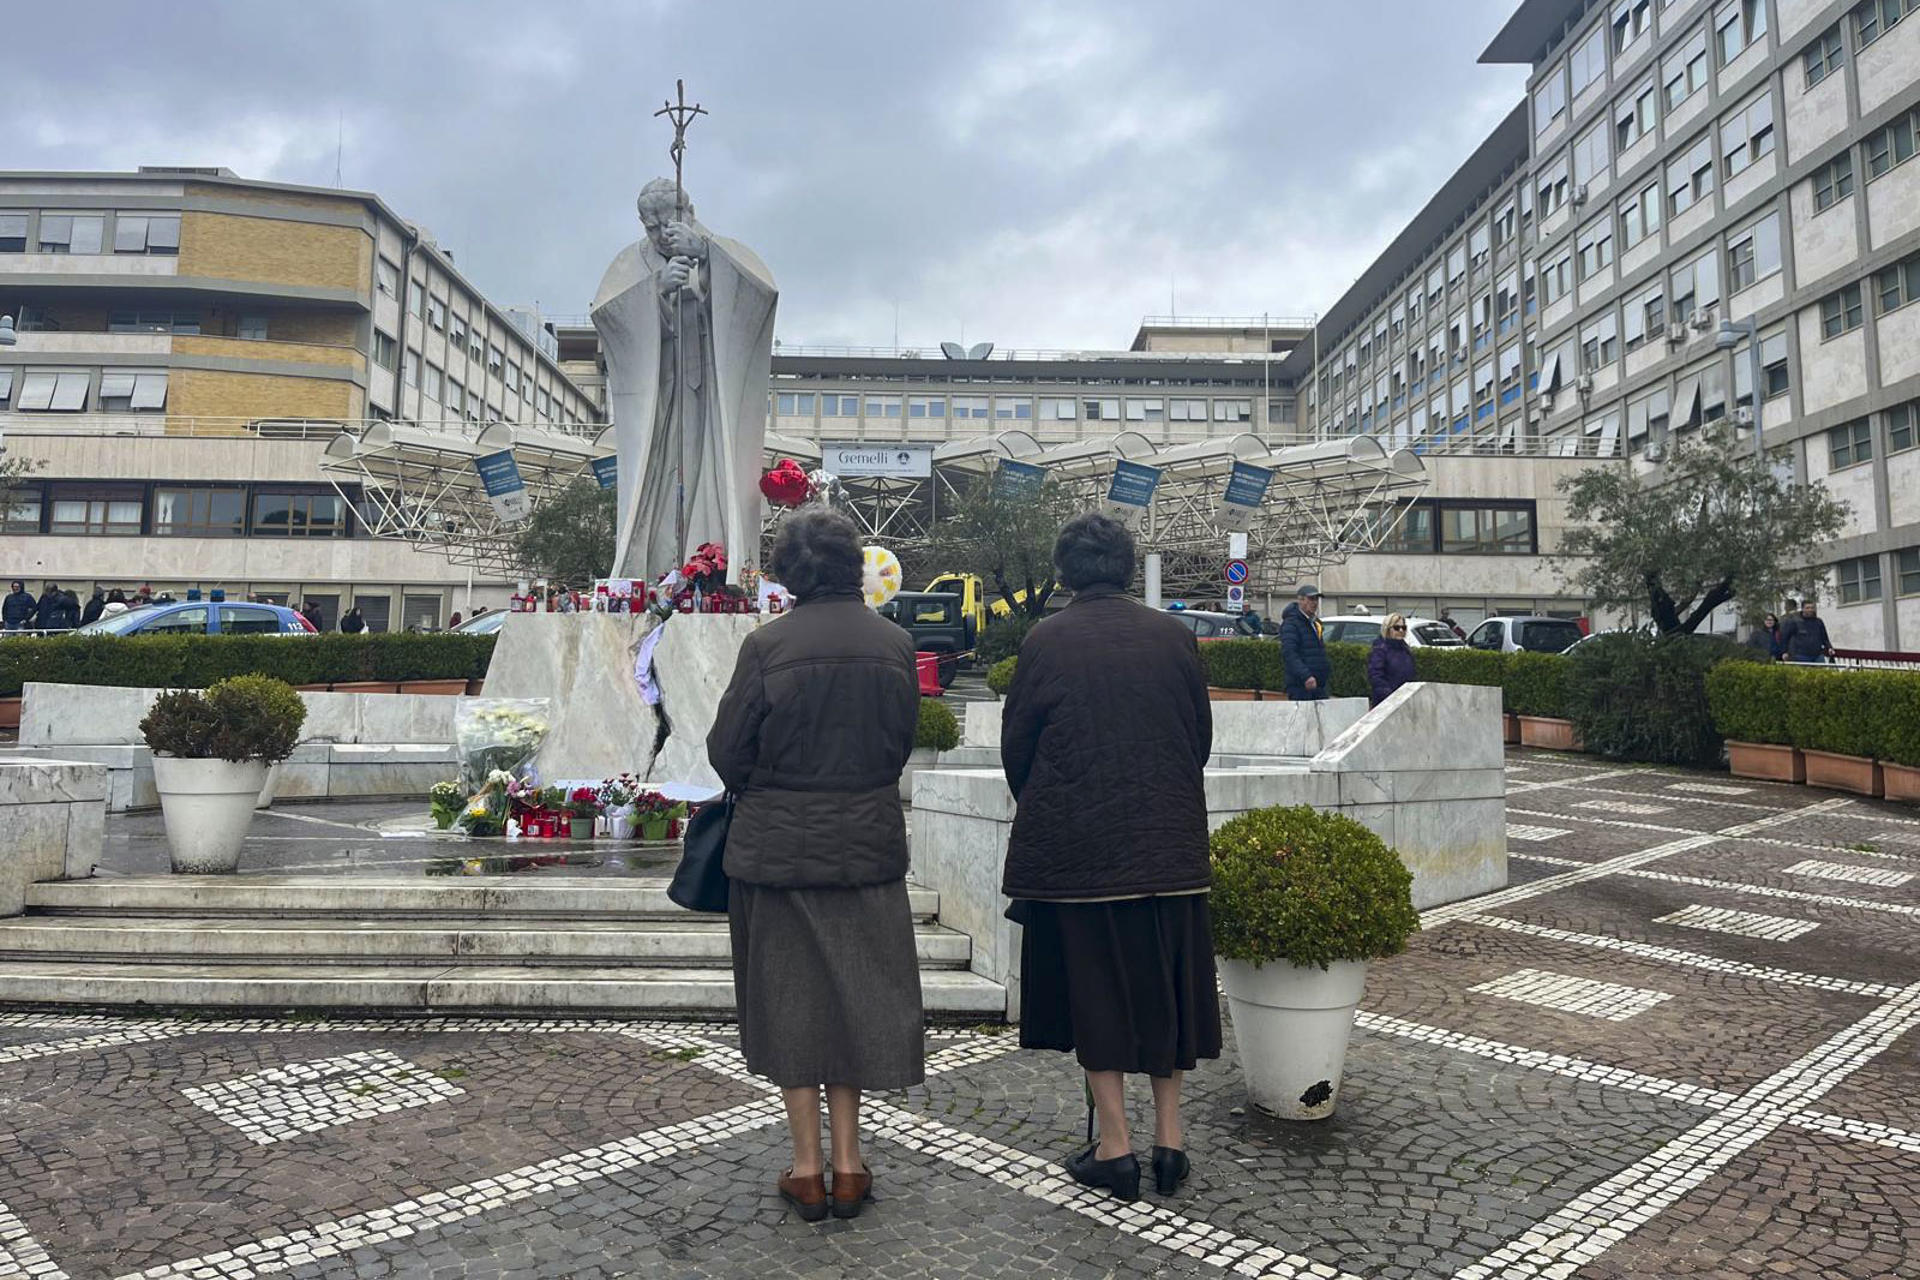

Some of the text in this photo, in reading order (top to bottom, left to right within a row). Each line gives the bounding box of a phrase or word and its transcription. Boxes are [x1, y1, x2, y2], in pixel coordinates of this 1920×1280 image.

[838, 452, 888, 464] Gemelli
[288, 622, 304, 630] 113
[1220, 627, 1234, 635] 112
